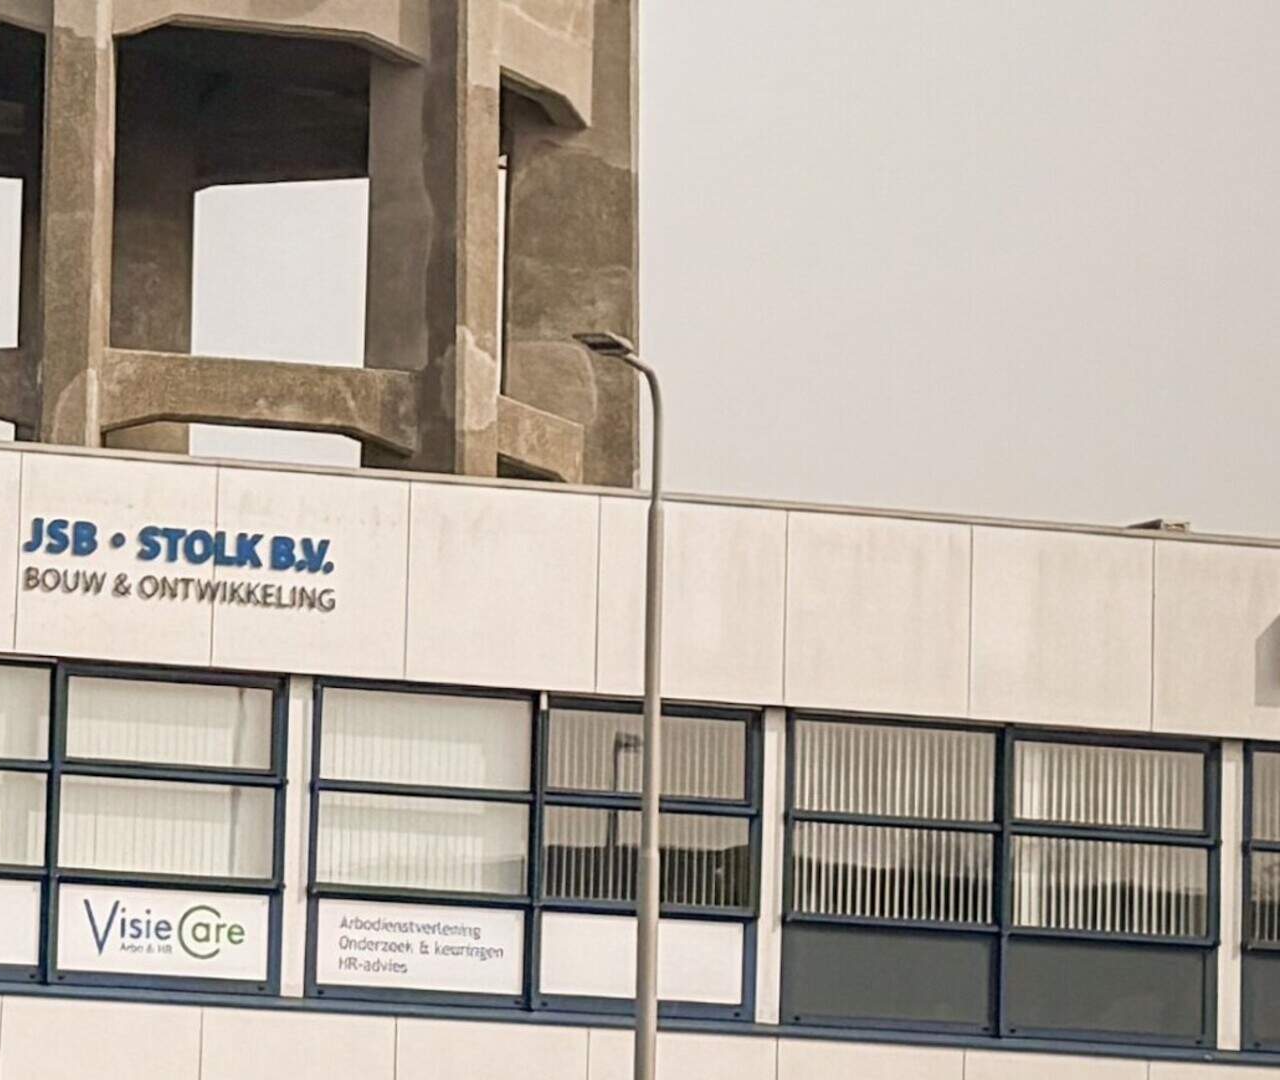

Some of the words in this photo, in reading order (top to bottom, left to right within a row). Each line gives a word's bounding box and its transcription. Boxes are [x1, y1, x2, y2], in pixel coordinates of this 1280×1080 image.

[22, 517, 99, 556] JSB
[137, 526, 264, 569] STOLK
[269, 535, 335, 575] B.V.
[22, 566, 107, 595] BOUW
[111, 573, 132, 596] &
[139, 574, 336, 612] ONTWIKKELING
[340, 916, 481, 940] Arbodienstverlening
[338, 935, 414, 954] Onderzoek
[419, 940, 430, 954] &
[434, 941, 504, 962] keuringen
[338, 957, 408, 974] HR-advies
